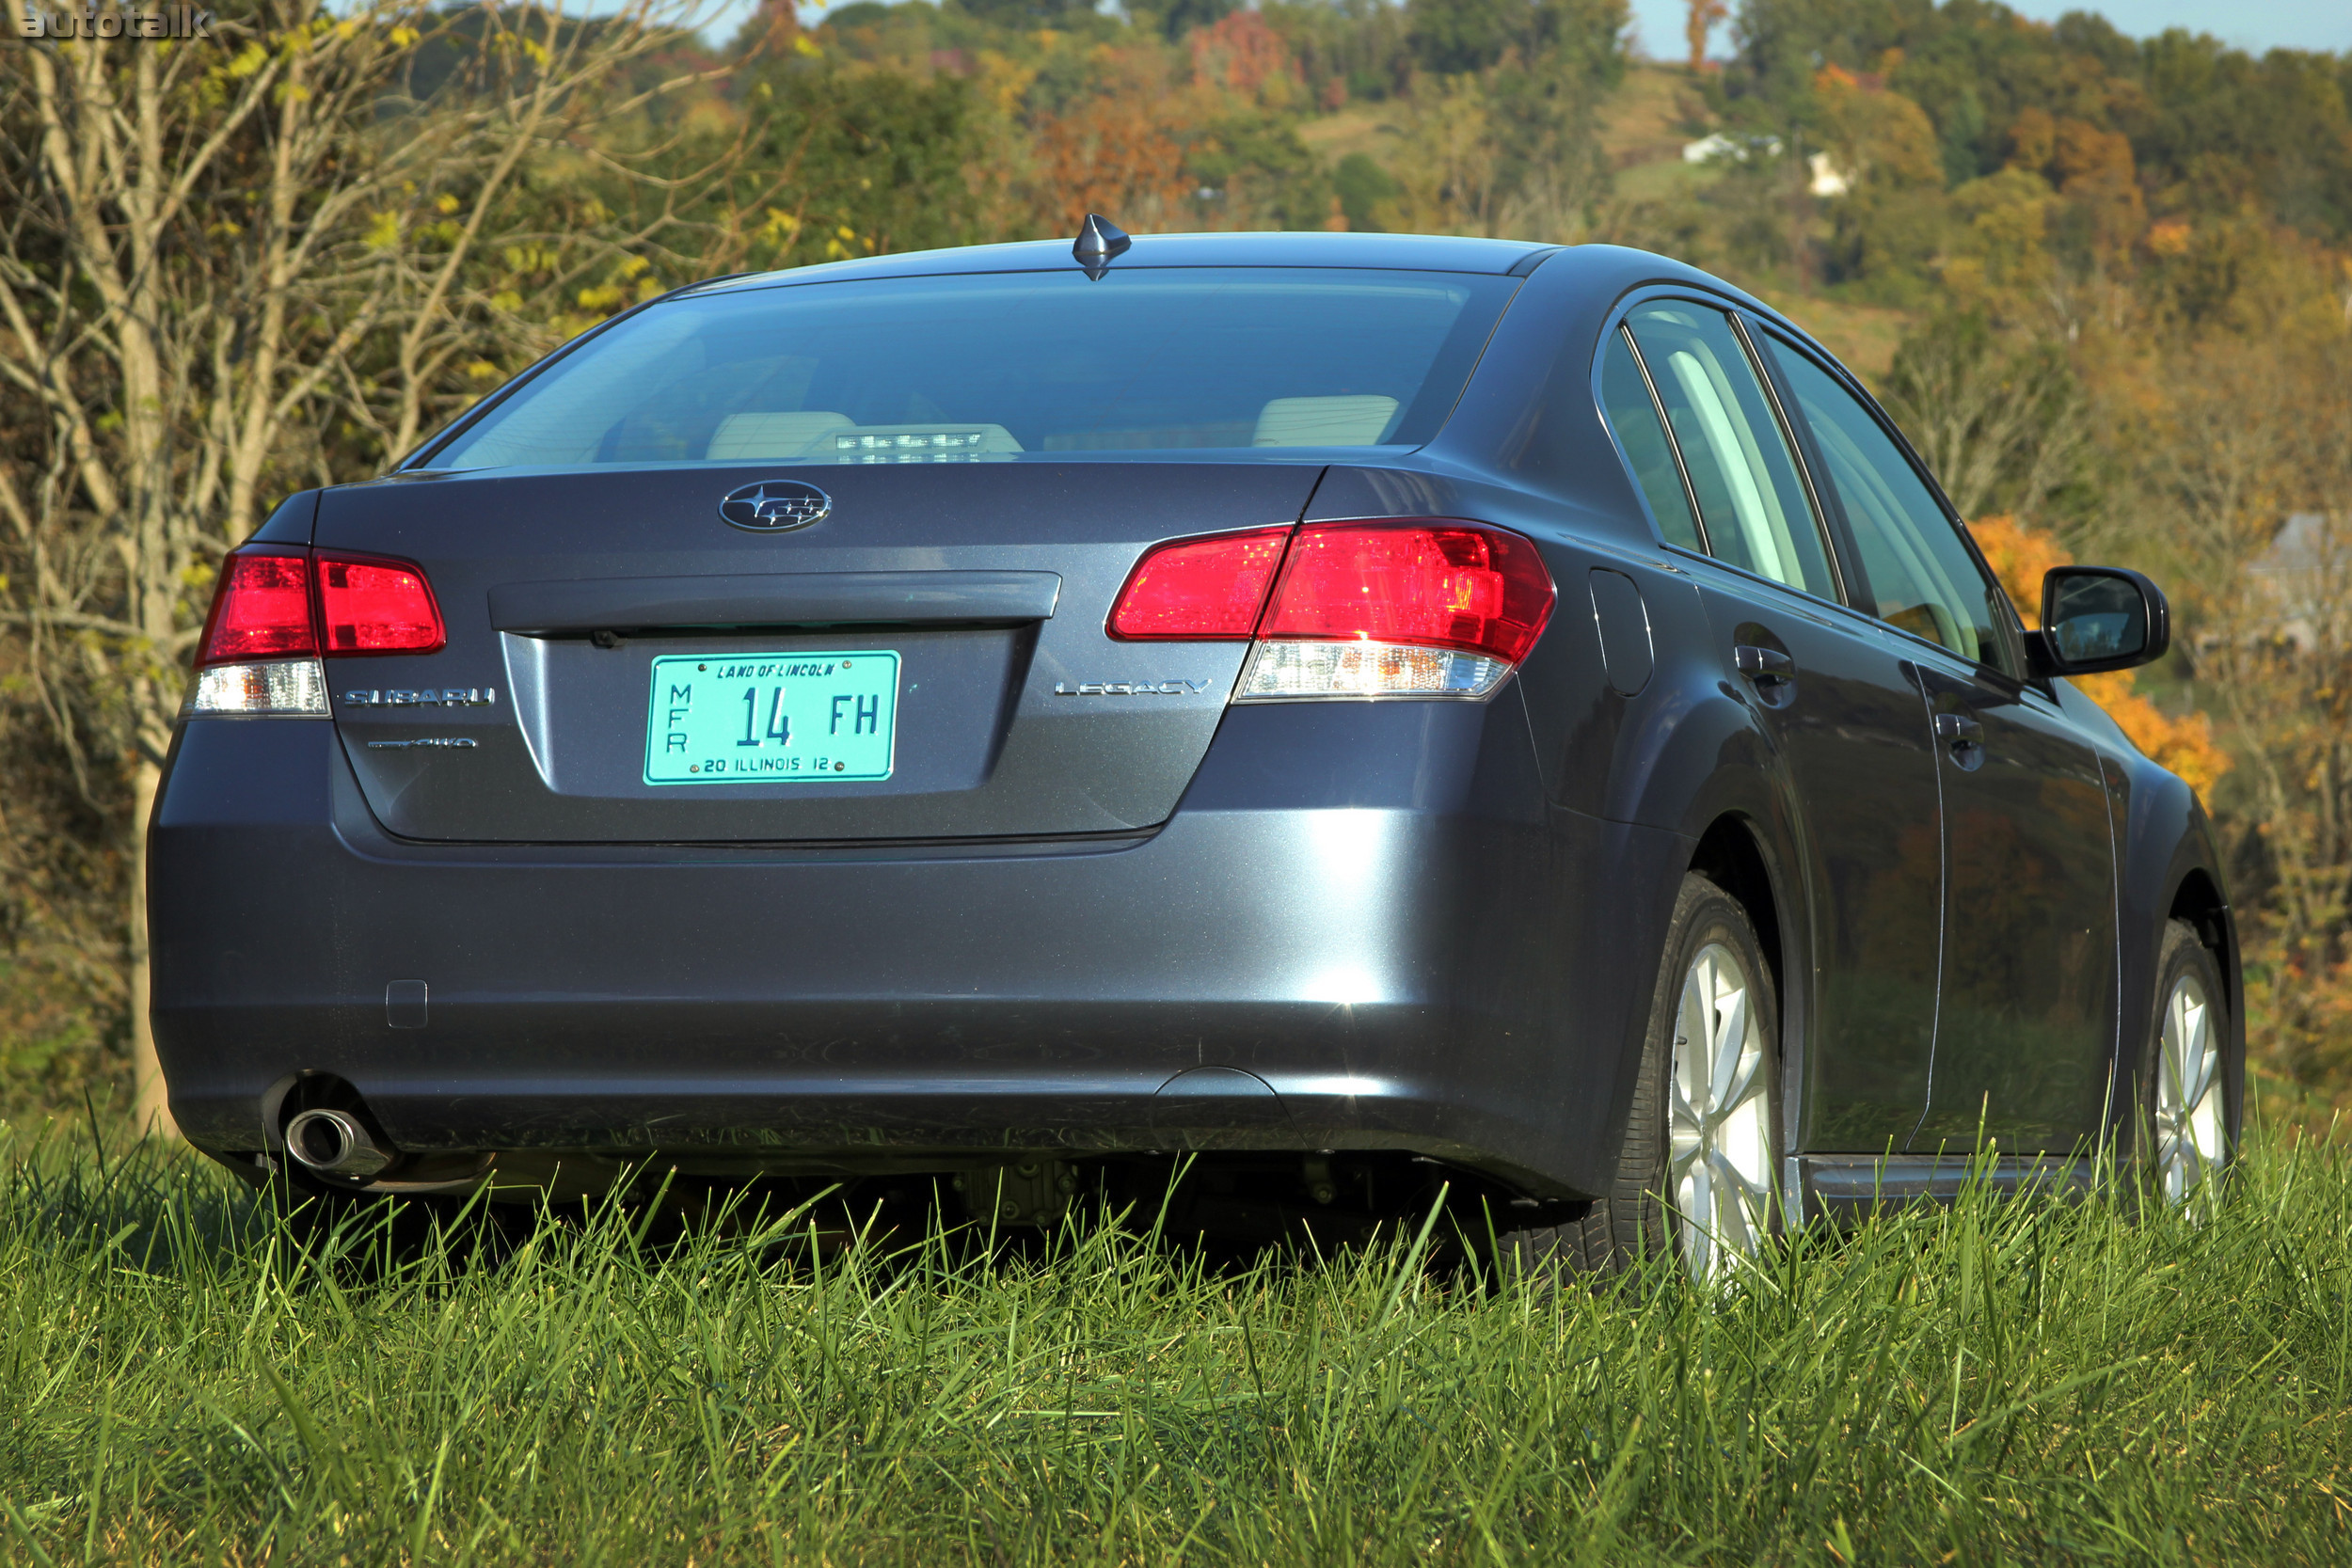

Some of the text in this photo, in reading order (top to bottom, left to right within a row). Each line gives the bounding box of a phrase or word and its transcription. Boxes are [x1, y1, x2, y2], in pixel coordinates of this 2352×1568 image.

[718, 662, 835, 678] LAND OF LINCOLN
[1055, 679, 1213, 696] LEGACY
[344, 688, 496, 706] SUBARU
[737, 687, 879, 747] 14 FH
[704, 756, 830, 772] 20 ILLINOIS 12
